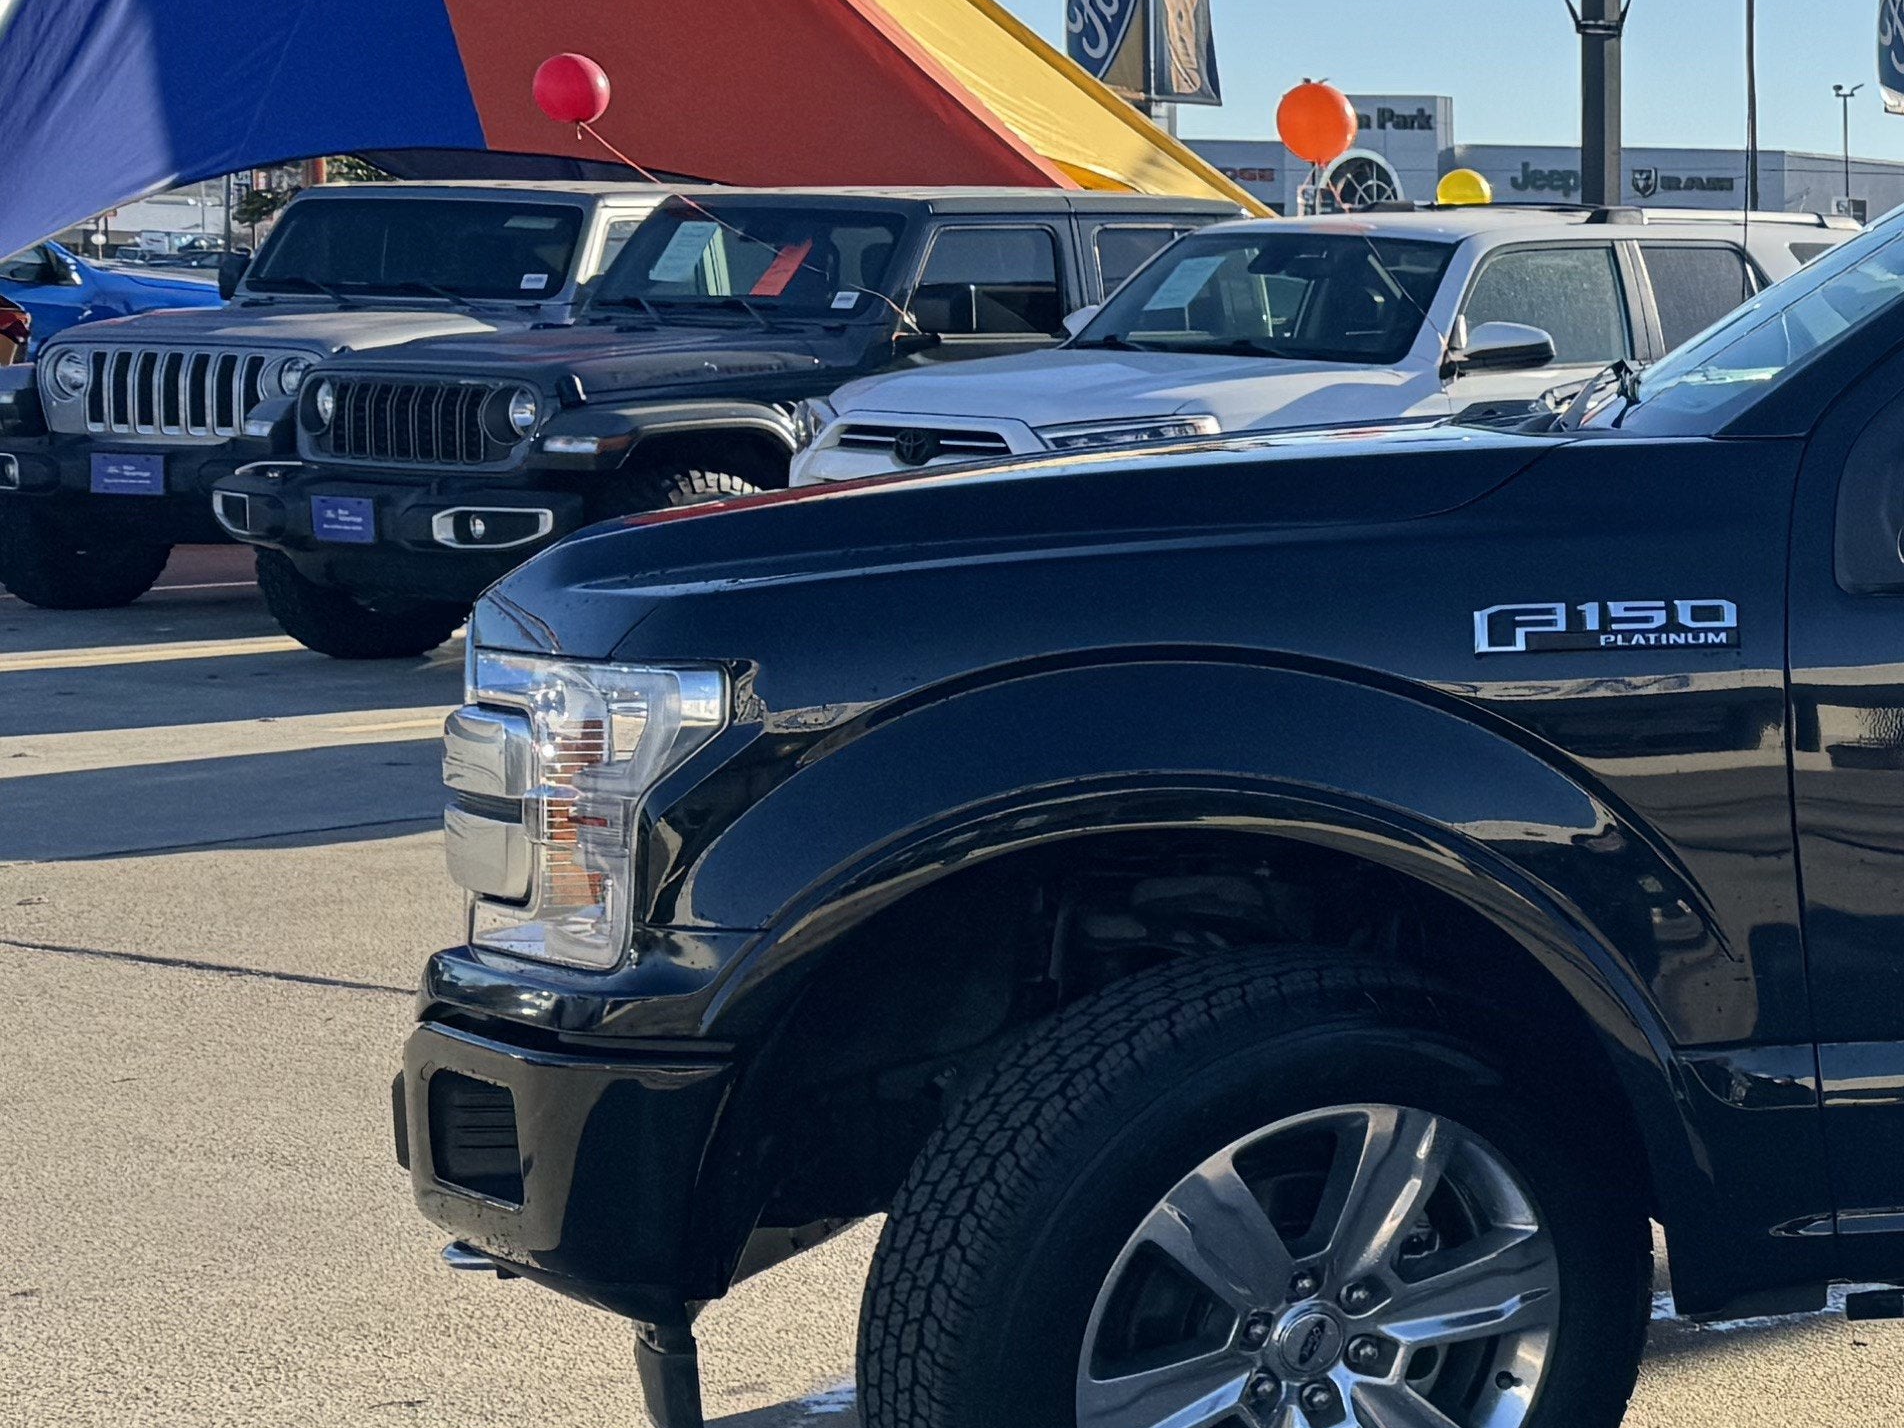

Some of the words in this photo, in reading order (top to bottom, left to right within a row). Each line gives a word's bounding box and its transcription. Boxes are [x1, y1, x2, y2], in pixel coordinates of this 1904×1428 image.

[1376, 107, 1434, 130] Park
[1510, 161, 1581, 199] Jeep
[1659, 175, 1734, 192] RAM
[1599, 632, 1728, 647] PLATINUM
